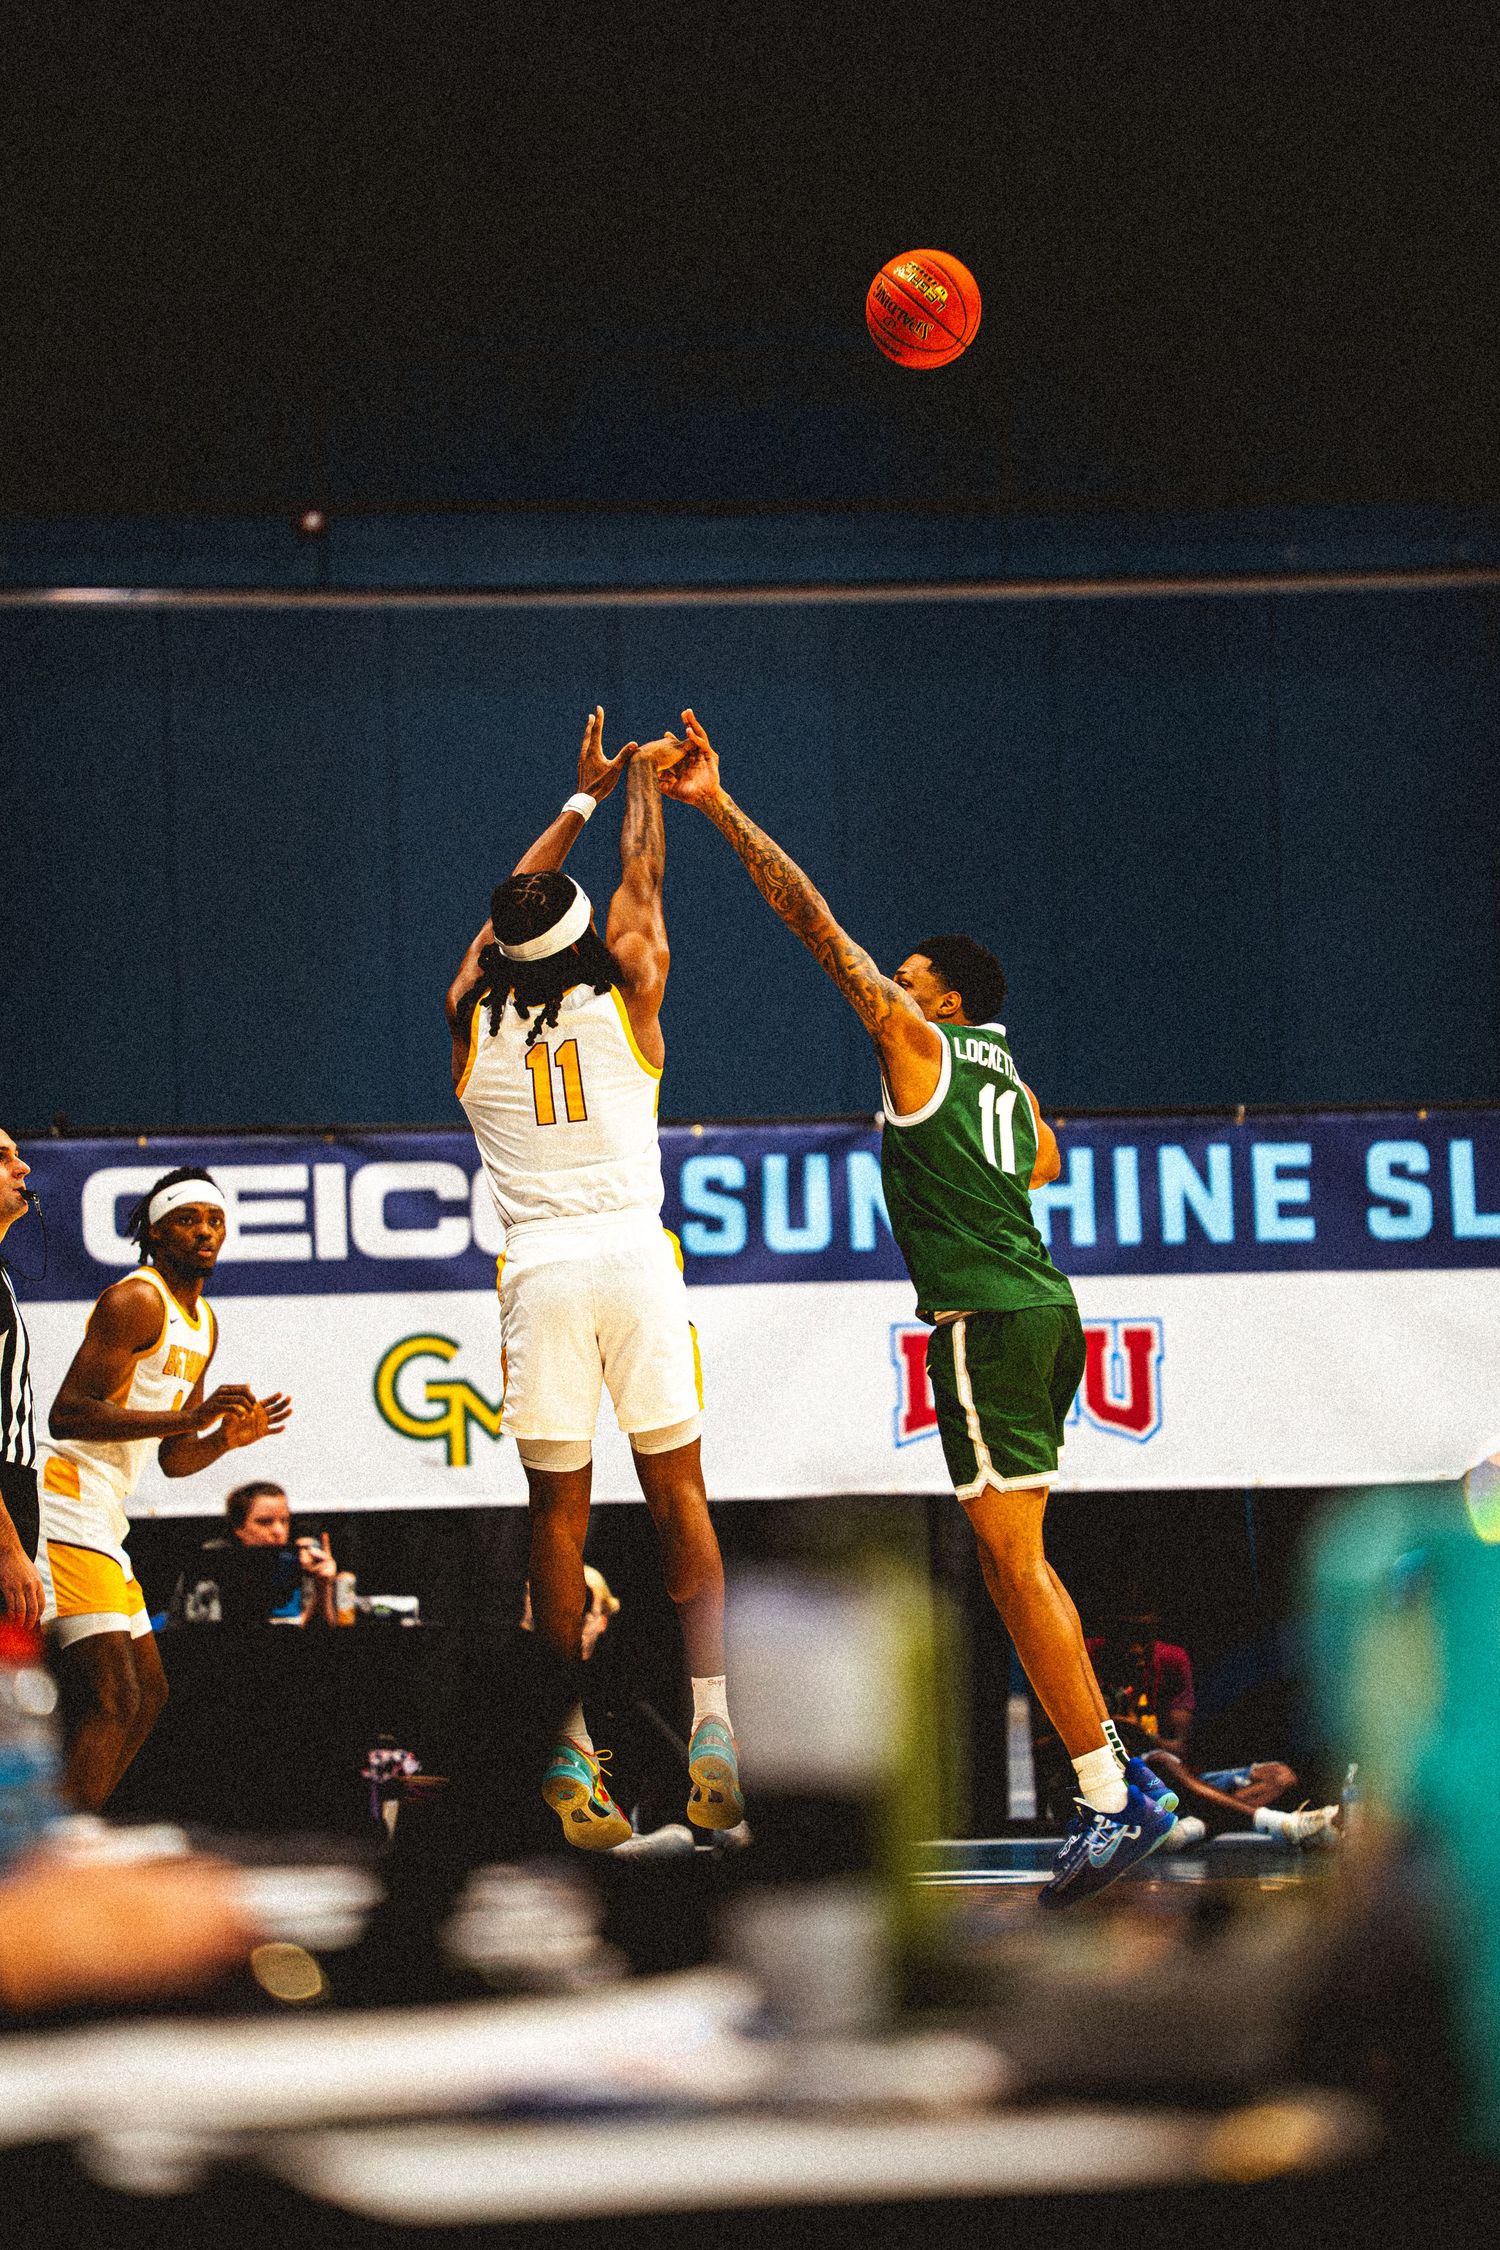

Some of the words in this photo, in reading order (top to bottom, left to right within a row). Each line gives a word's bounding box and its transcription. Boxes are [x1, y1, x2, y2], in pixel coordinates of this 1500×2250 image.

[874, 280, 935, 341] SPALDING
[525, 1038, 588, 1126] 11
[978, 1082, 1018, 1175] 11
[680, 1142, 1317, 1256] SUNHINE
